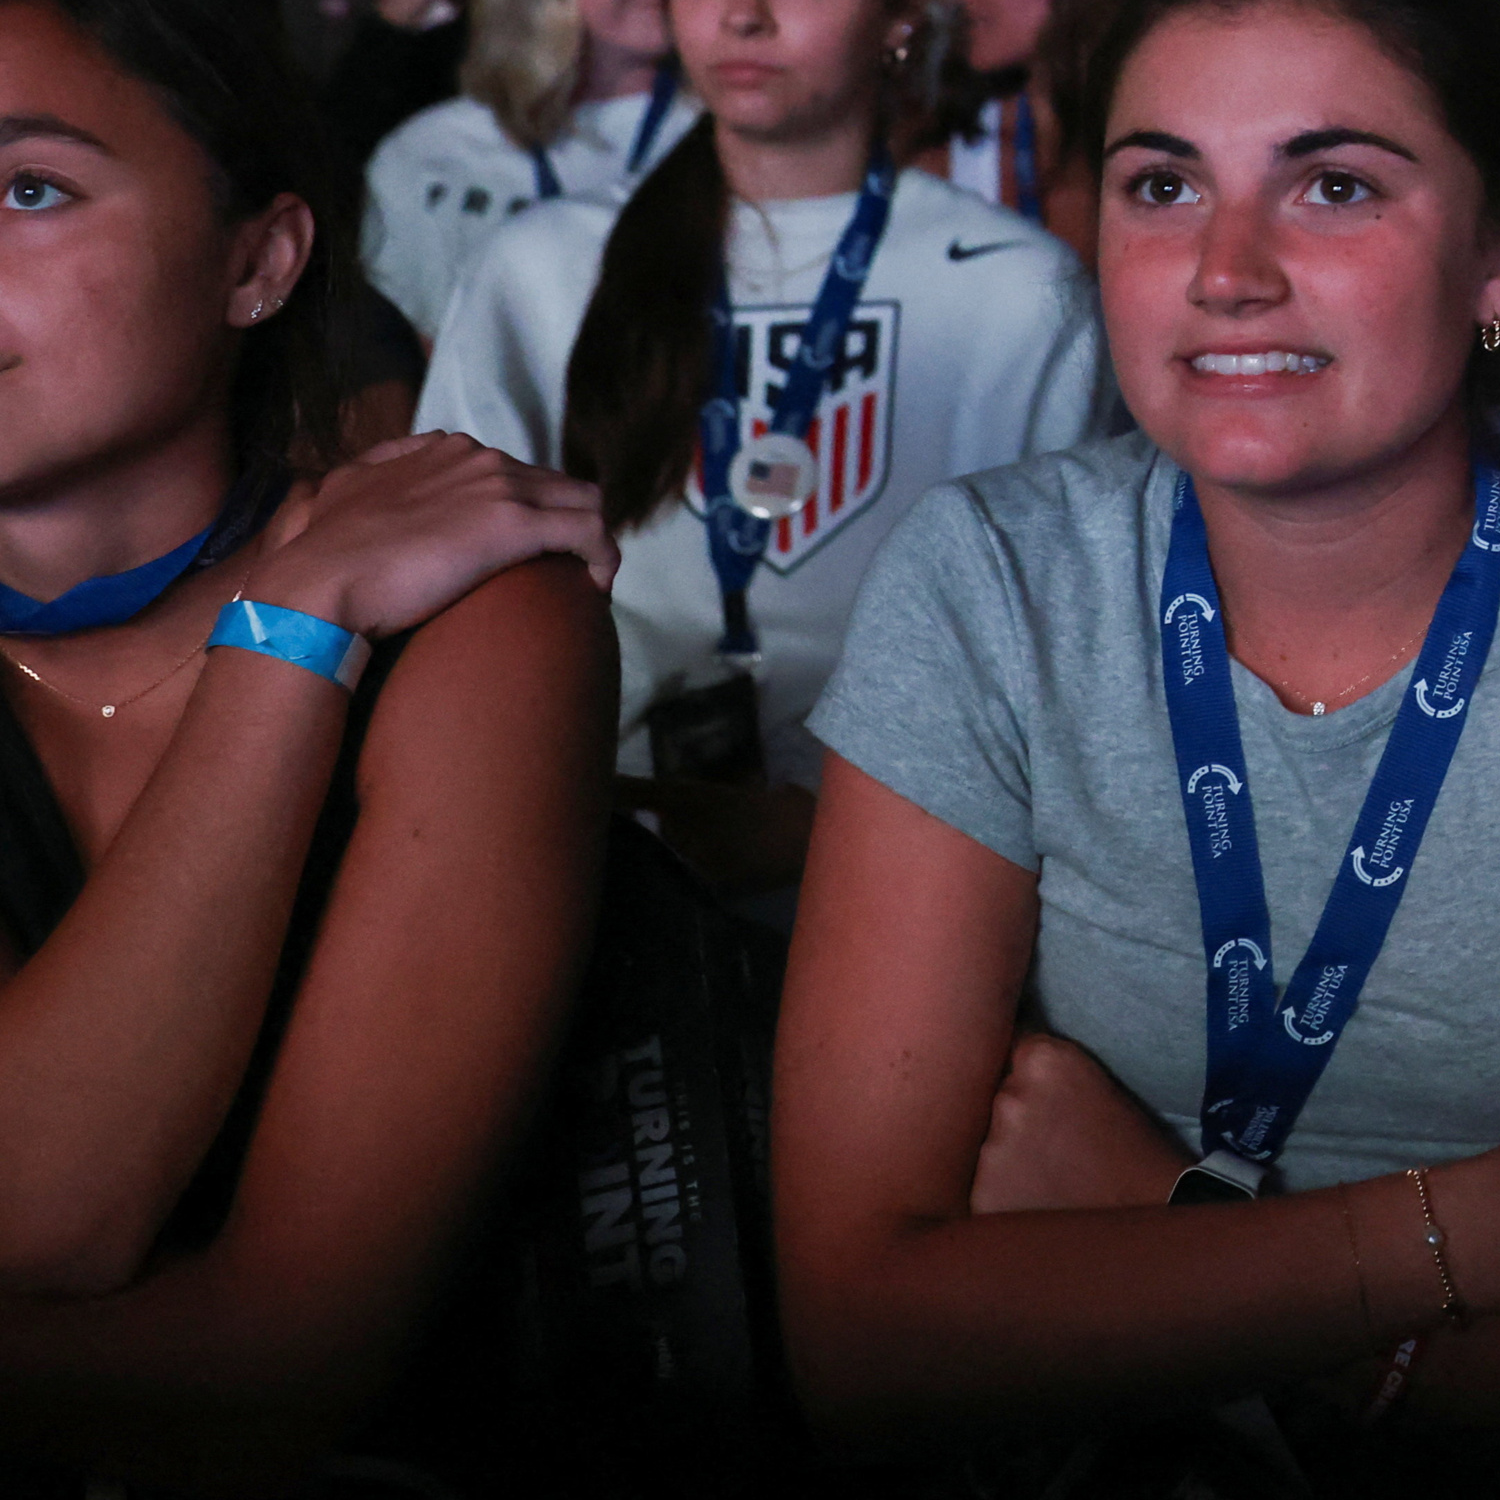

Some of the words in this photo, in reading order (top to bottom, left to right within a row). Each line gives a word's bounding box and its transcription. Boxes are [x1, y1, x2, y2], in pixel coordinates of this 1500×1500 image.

[1178, 614, 1192, 657] POINT
[1188, 610, 1204, 677] TURNING
[1433, 633, 1460, 697] TURNING
[1443, 658, 1464, 701] POINT
[1458, 631, 1473, 656] USA
[1182, 658, 1194, 686] USA
[1202, 785, 1219, 829] POINT
[1213, 782, 1232, 851] TURNING
[1370, 801, 1401, 865] TURNING
[1380, 825, 1403, 869] POINT
[1396, 798, 1414, 823] USA
[1210, 831, 1222, 859] USA
[1228, 960, 1239, 1004] POINT
[1239, 957, 1250, 1024] TURNING
[1300, 965, 1335, 1026] TURNING
[1310, 990, 1335, 1031] POINT
[1330, 965, 1348, 989] USA
[1228, 1005, 1238, 1032] USA
[622, 1034, 688, 1287] TURNING
